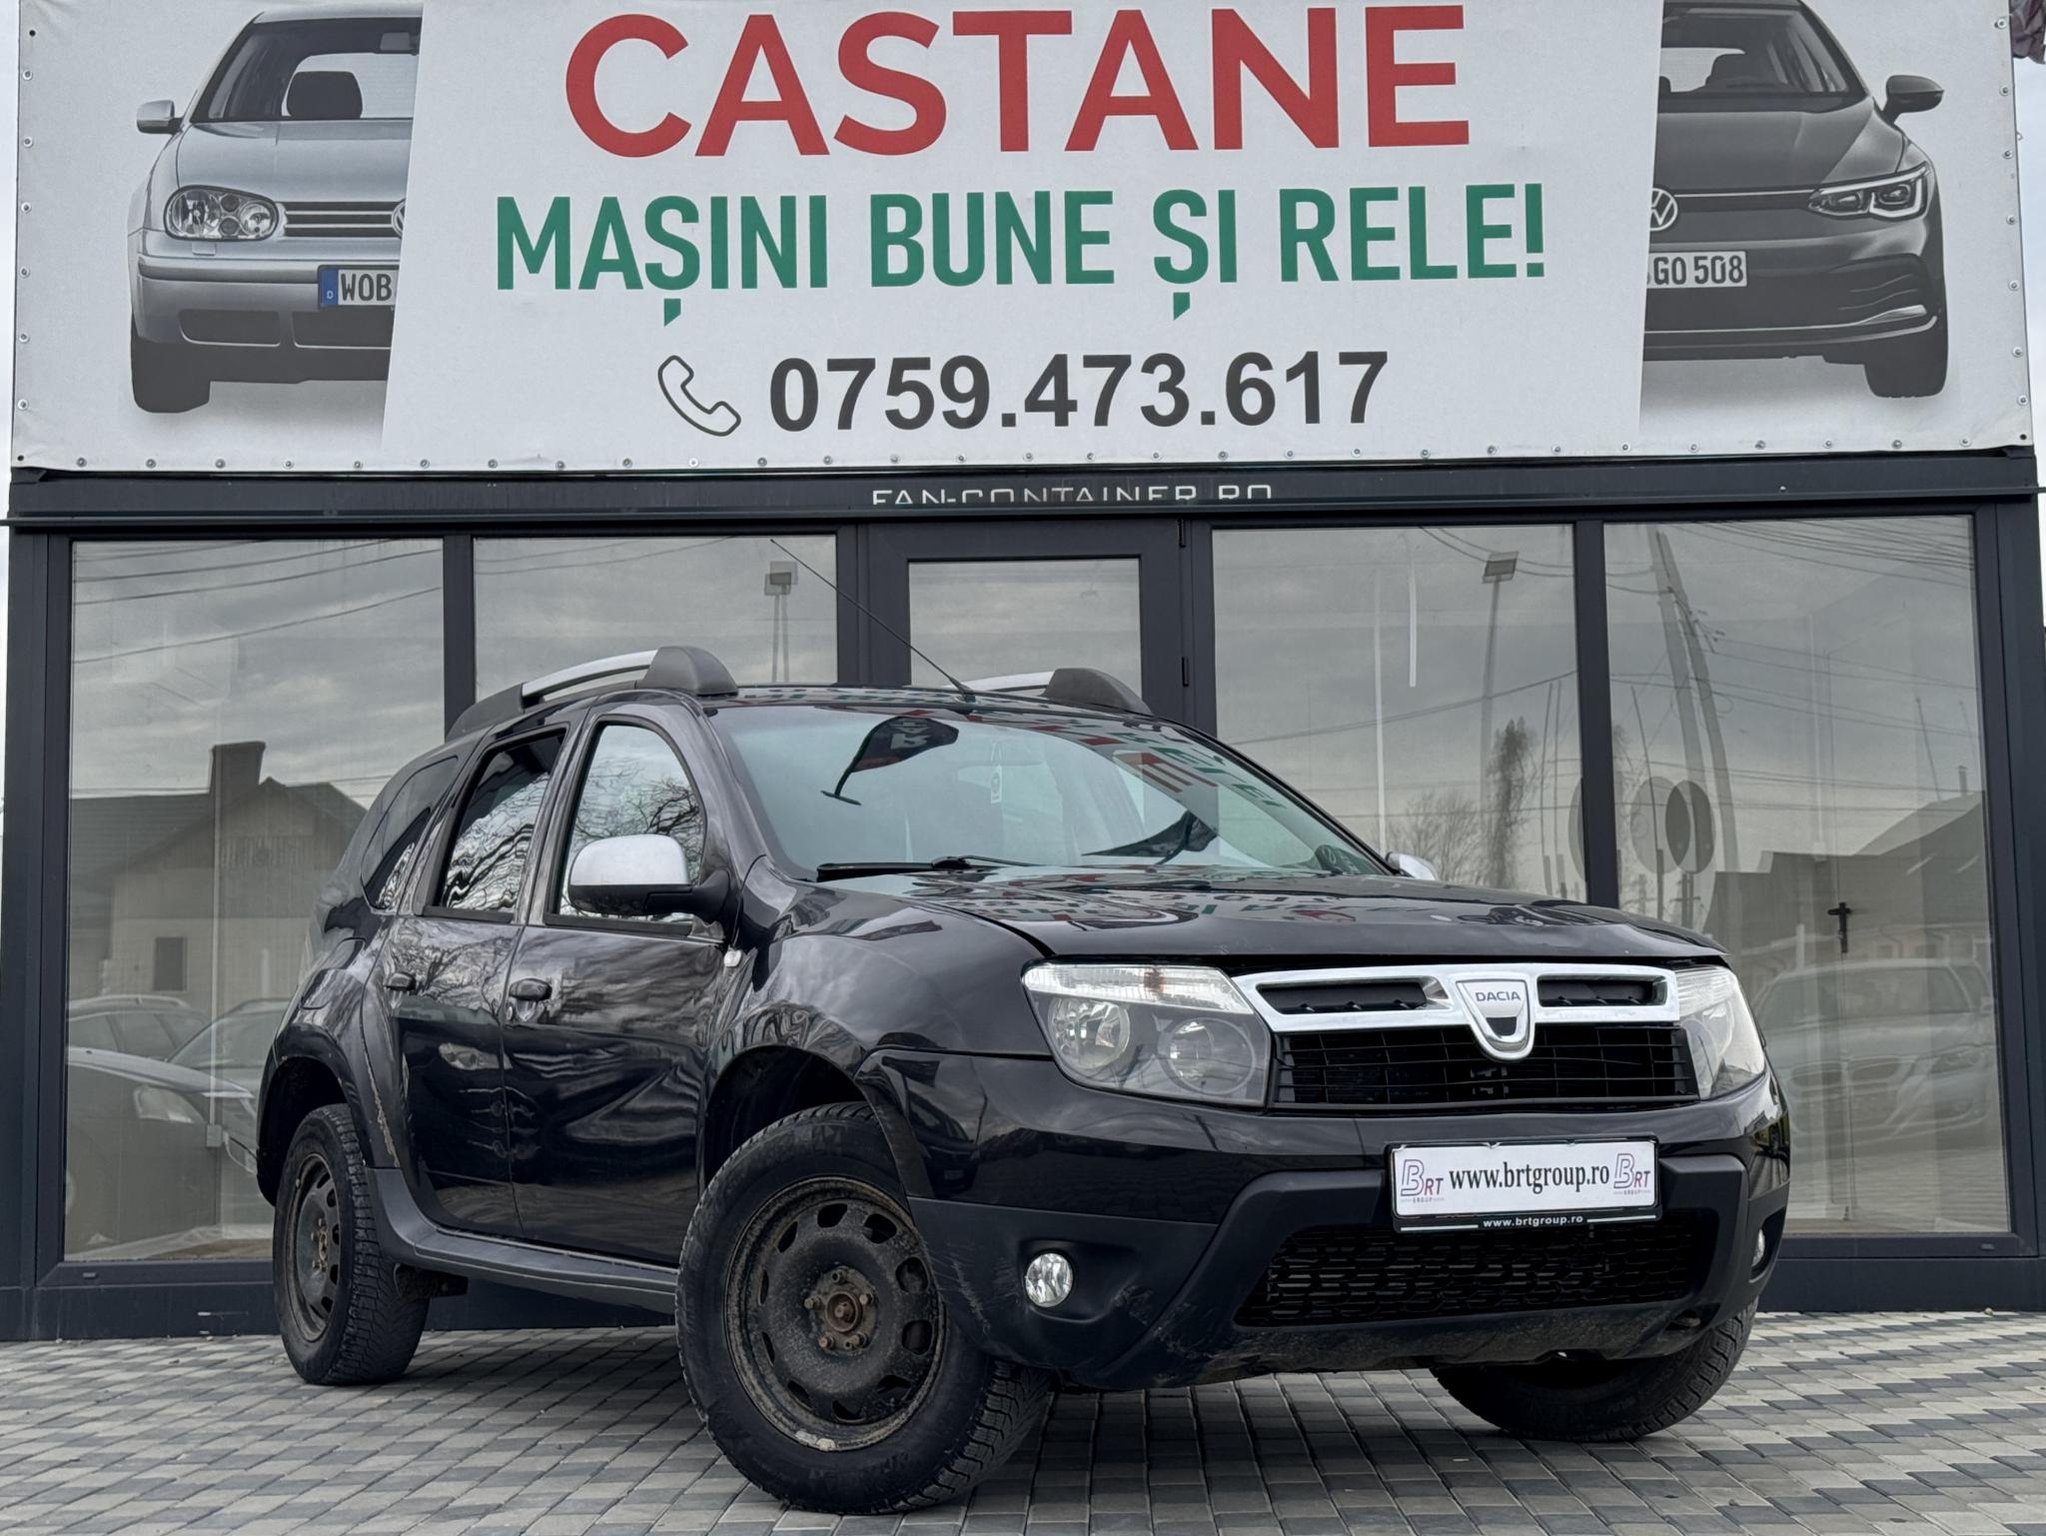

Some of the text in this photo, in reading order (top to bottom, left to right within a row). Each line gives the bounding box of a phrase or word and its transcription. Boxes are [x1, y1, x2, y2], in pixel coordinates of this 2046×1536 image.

[567, 7, 1468, 156] CASTANE
[498, 184, 1544, 327] MAȘINI BUNE ȘI RELE!
[1693, 255, 1744, 284] 508
[341, 273, 393, 302] WOB
[769, 350, 1388, 432] 0759.473.617
[1475, 991, 1521, 1002] DACIA
[1449, 1161, 1610, 1195] www.brtgroup.ro
[1483, 1215, 1584, 1228] www.brtgroup.ro
